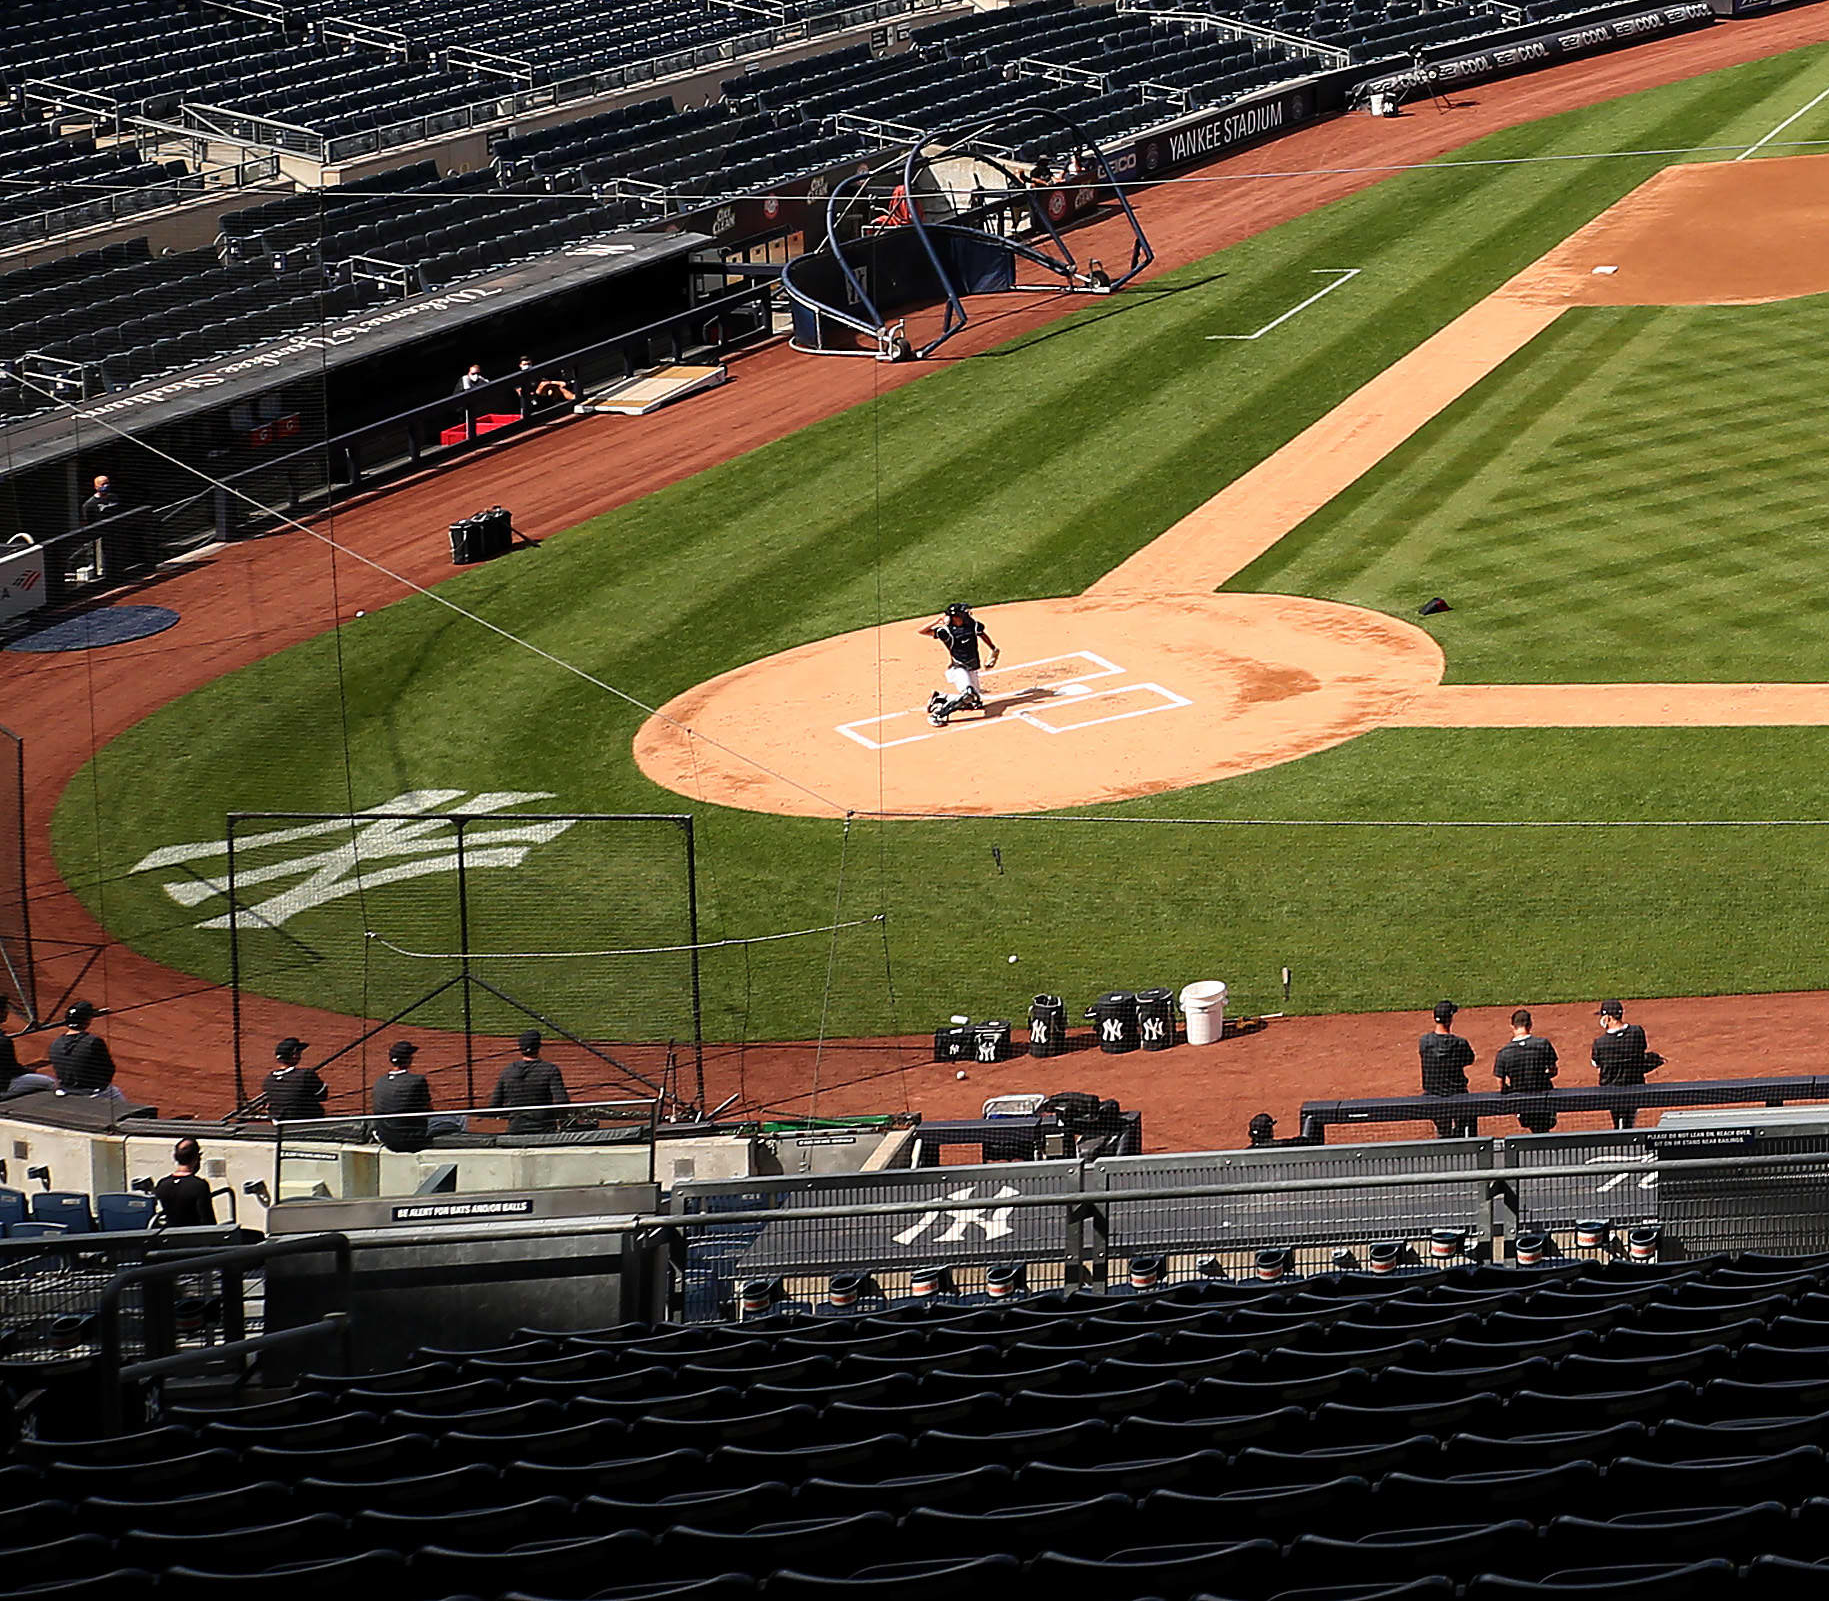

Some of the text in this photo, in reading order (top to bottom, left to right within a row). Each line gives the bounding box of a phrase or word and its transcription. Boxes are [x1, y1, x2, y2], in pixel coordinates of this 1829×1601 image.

[1635, 14, 1664, 31] COOL
[1582, 27, 1612, 45] COOL
[1517, 42, 1549, 61] COOL
[1459, 55, 1492, 74] COOL
[1169, 101, 1283, 164] YANKEE STADIUM
